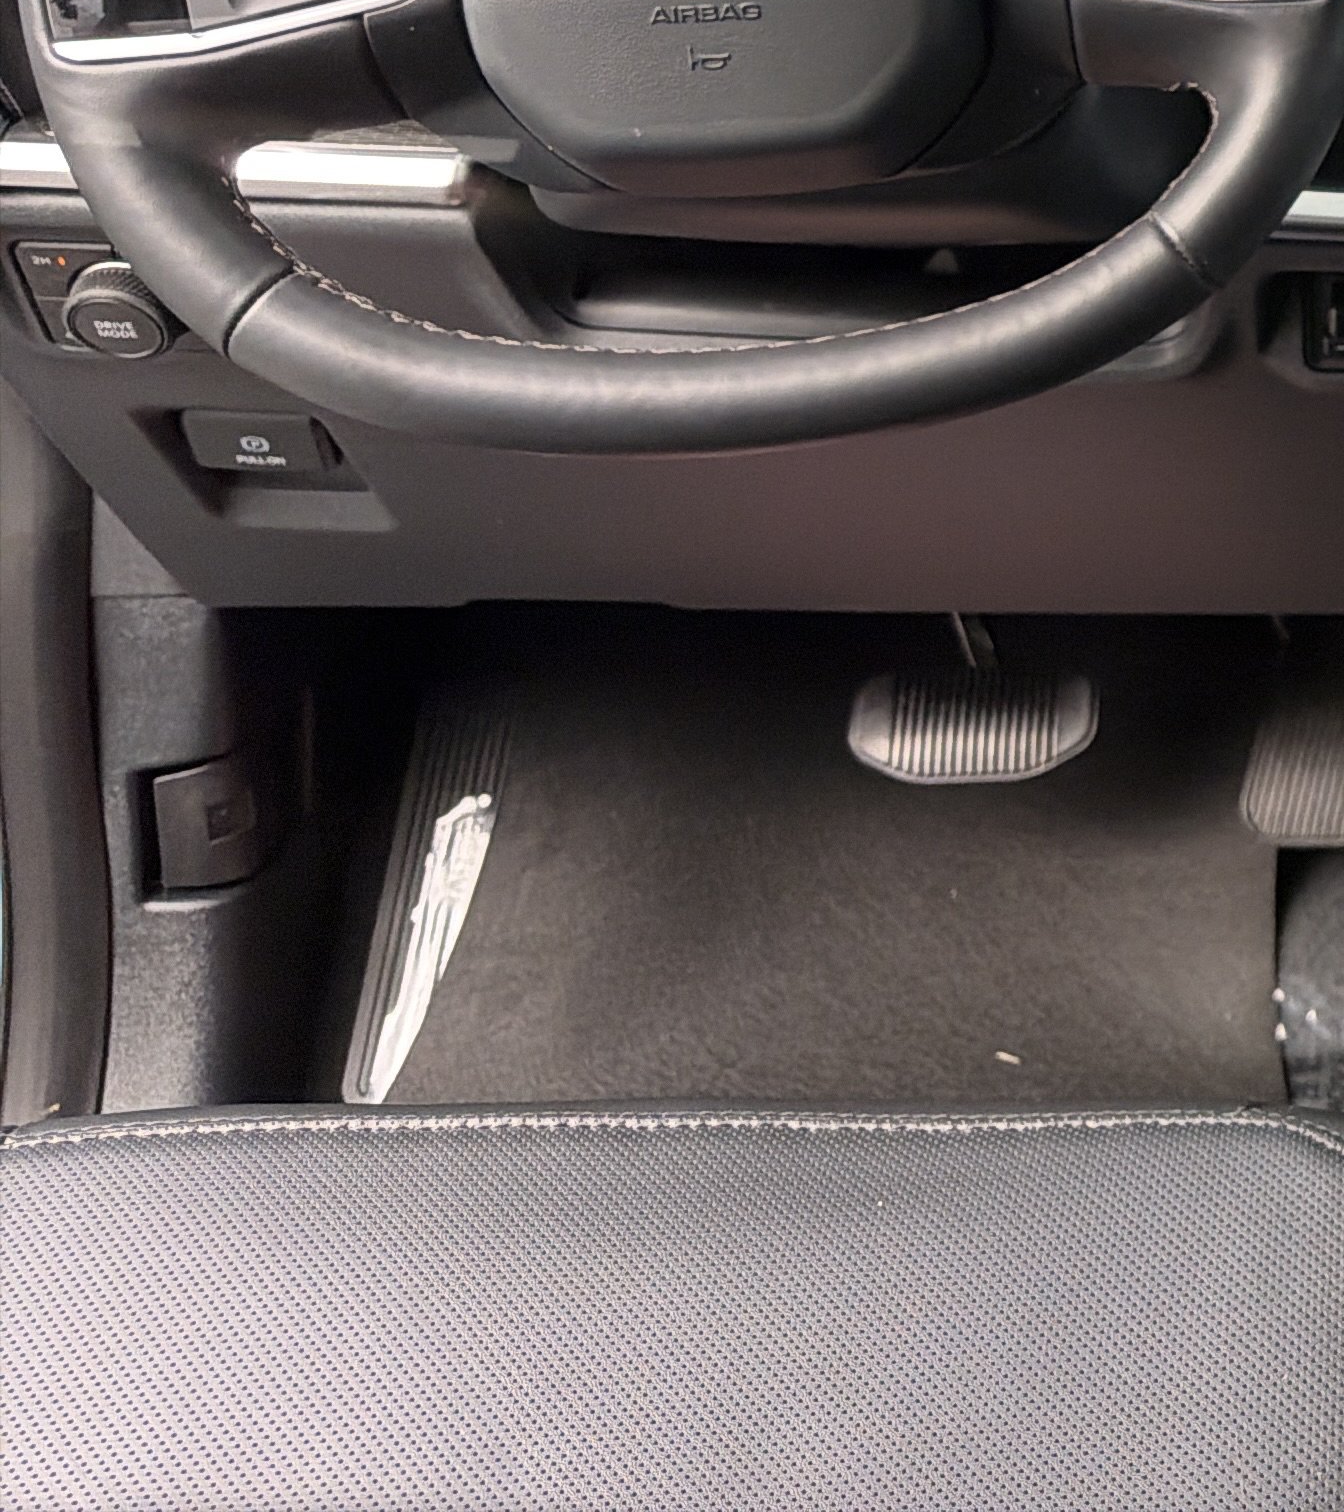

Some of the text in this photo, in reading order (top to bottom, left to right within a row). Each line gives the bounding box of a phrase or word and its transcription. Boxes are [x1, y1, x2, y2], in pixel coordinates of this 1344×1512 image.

[651, 1, 763, 25] AIRBAG
[93, 320, 135, 330] DRIVE
[97, 329, 139, 339] MODE
